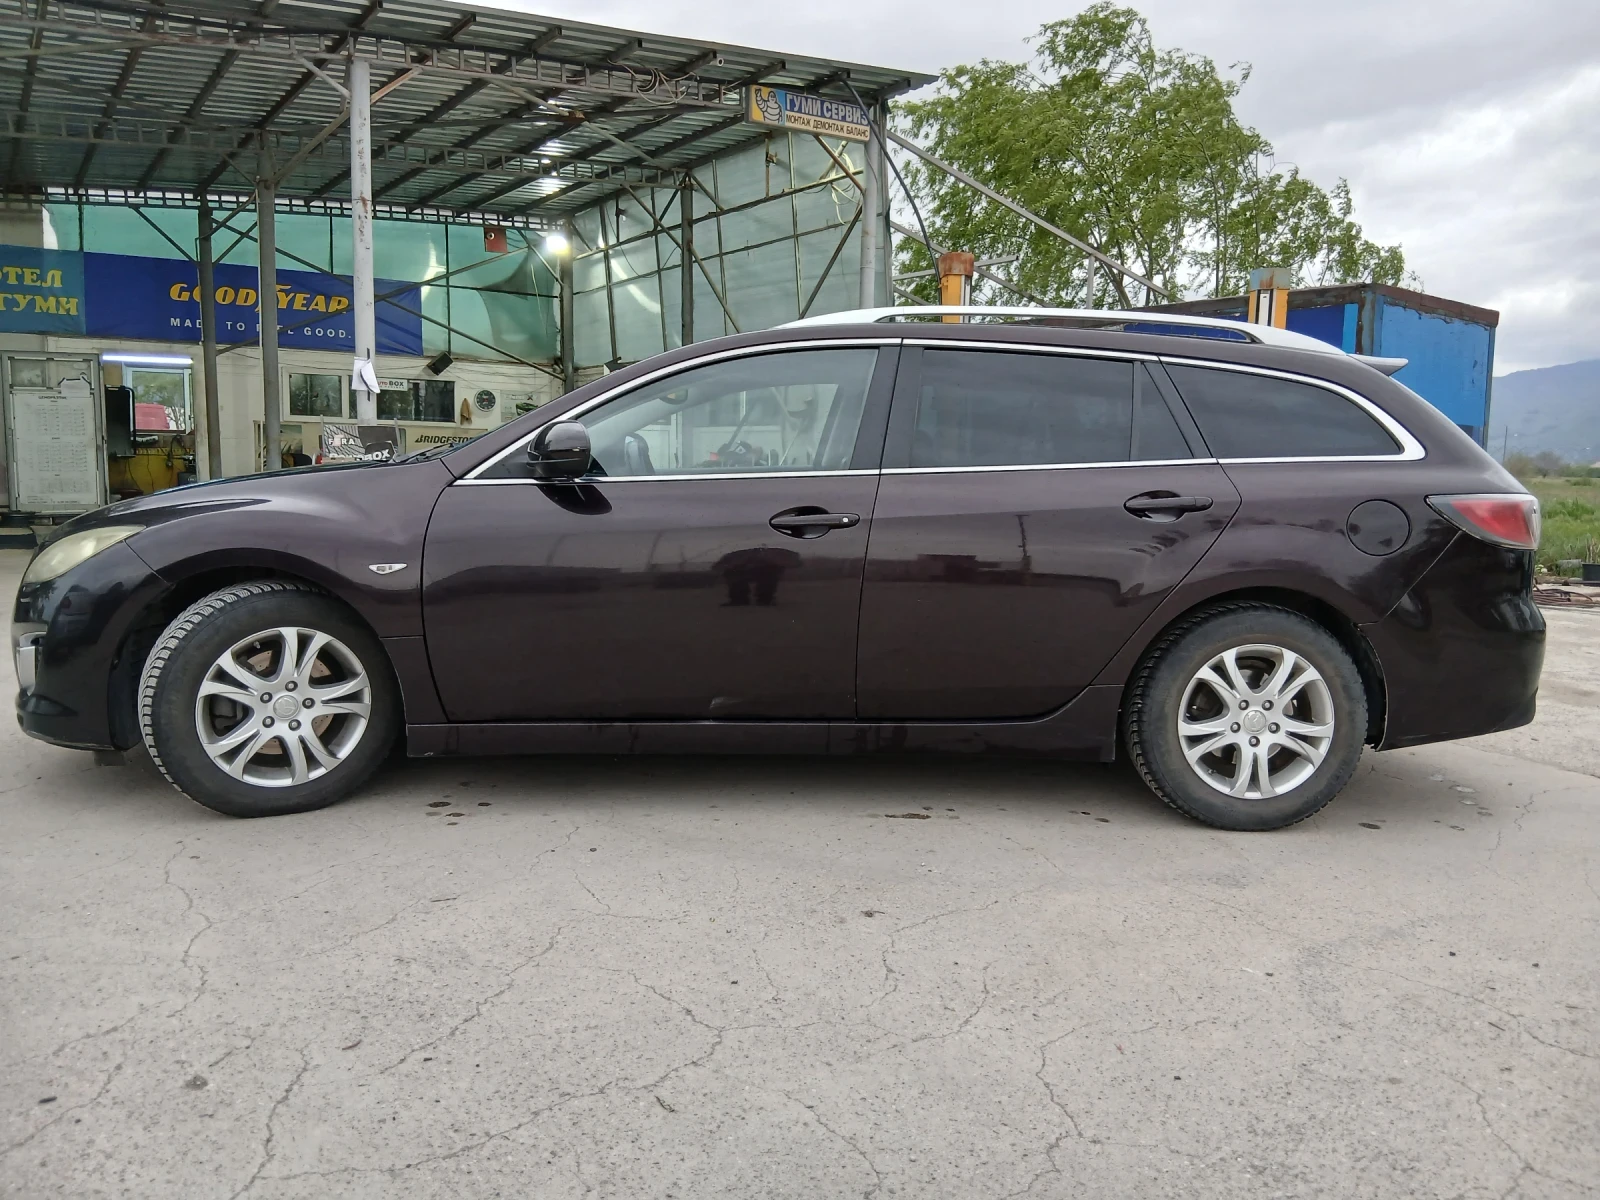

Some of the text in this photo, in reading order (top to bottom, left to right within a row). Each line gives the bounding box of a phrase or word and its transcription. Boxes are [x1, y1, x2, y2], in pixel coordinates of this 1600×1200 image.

[786, 93, 869, 126] ГУМИ СЕРВИЗ
[786, 114, 869, 139] МОНТАЖ ДЕМОНТАЖ БАЛАНС
[0, 266, 63, 288] ТЕЛ
[0, 293, 79, 316] ГУМИ
[170, 317, 203, 329] MAD
[225, 321, 246, 331] TO
[303, 326, 351, 339] GOOD.
[415, 434, 474, 444] BRIDGESTO
